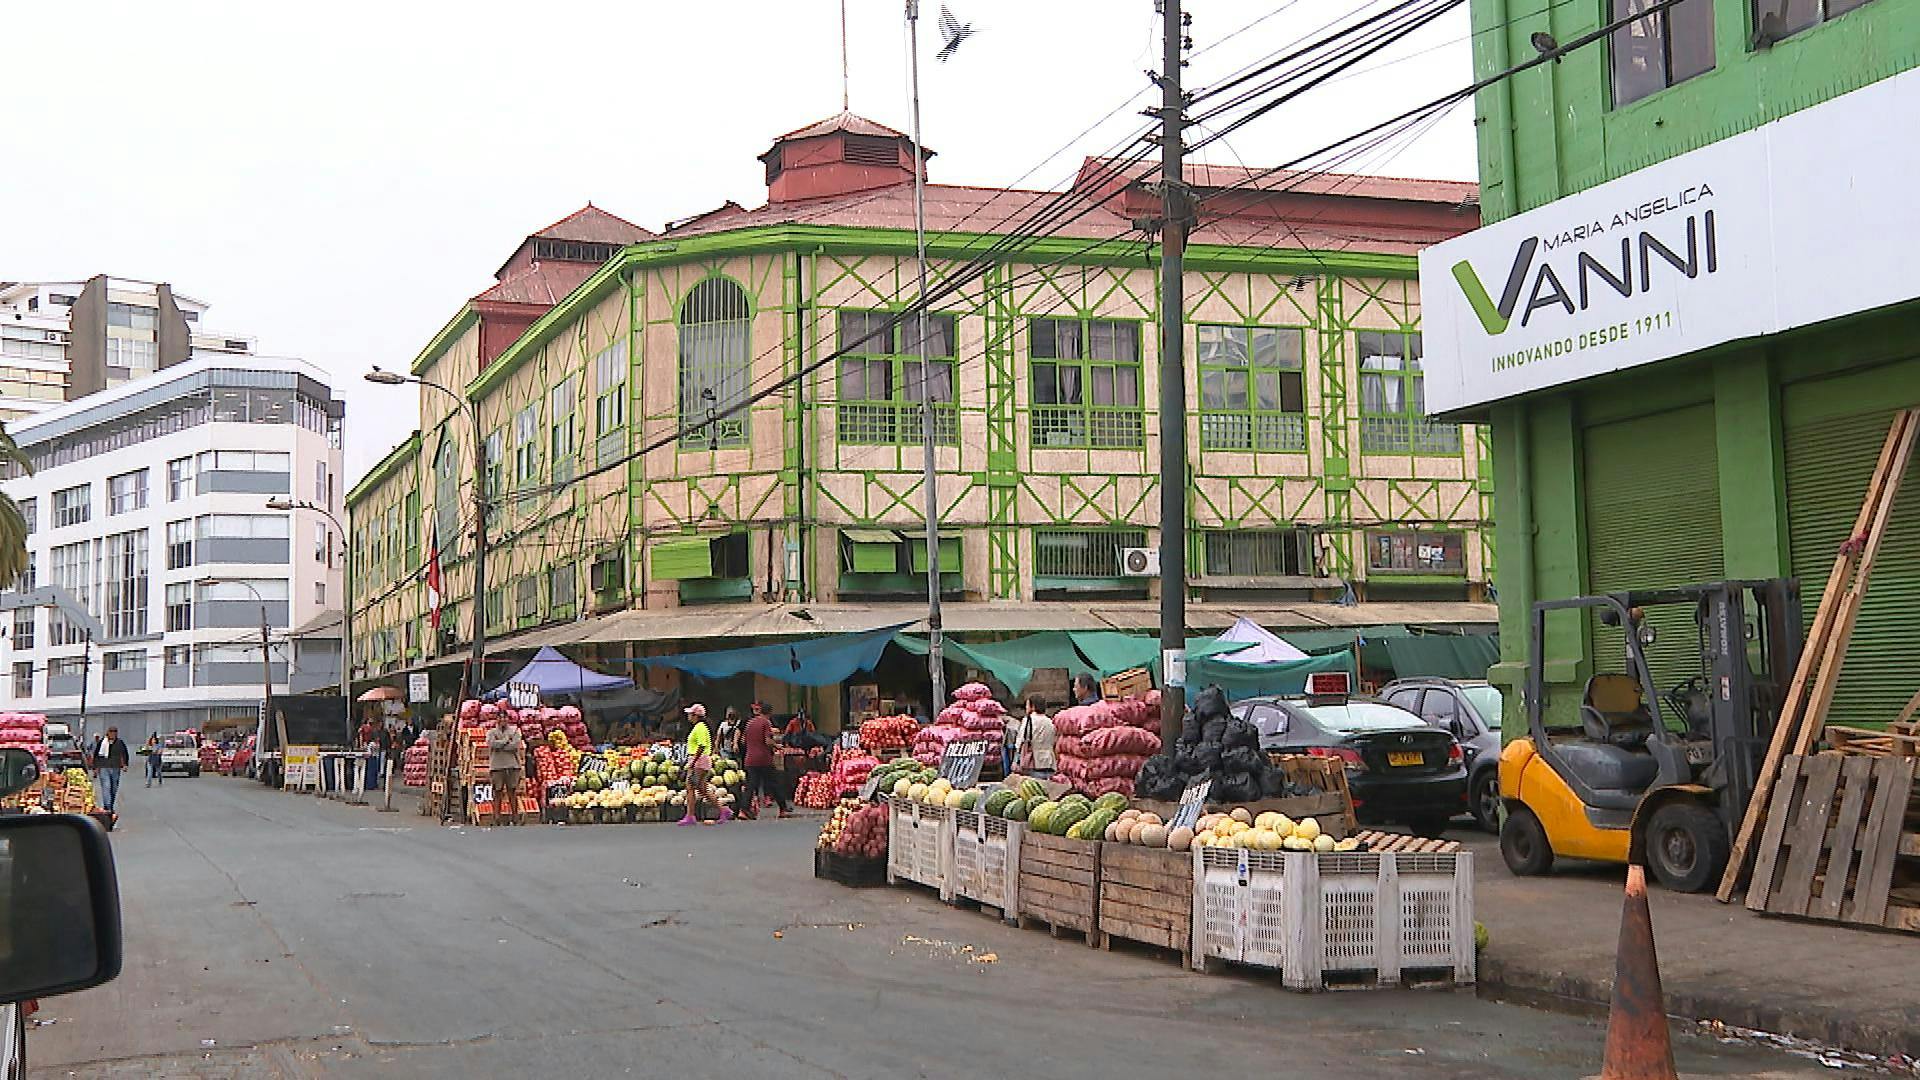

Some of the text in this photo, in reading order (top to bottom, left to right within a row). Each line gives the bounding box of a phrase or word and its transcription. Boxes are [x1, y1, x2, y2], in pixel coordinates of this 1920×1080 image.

[1543, 183, 1714, 252] MARIA ANGELICA
[1451, 209, 1717, 335] VANNI
[1491, 311, 1672, 373] INNOVANDO DESDE 1911
[1719, 602, 1729, 655] KOMATSU
[945, 740, 988, 757] MELONES
